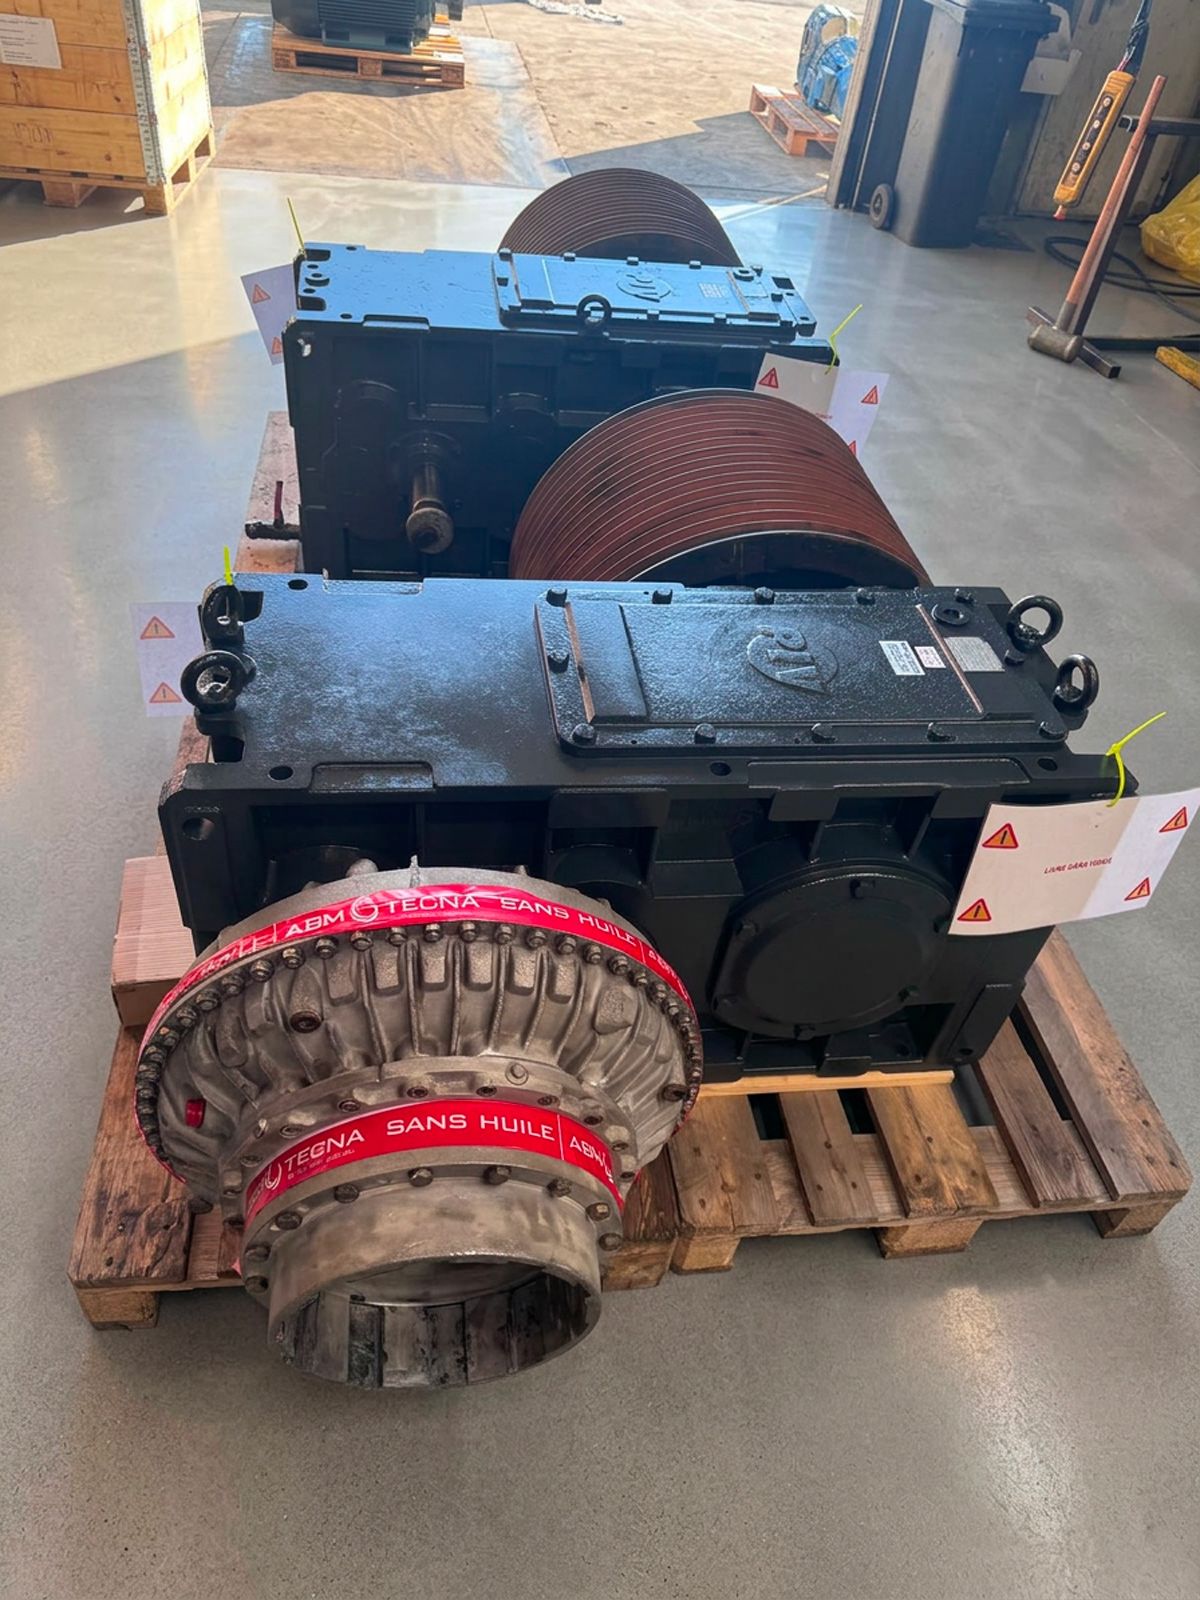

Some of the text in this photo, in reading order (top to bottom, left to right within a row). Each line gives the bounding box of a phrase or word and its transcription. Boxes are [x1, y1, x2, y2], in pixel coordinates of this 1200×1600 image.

[285, 910, 345, 938] ABM
[386, 895, 480, 914] TECNA
[500, 898, 570, 919] SANS
[386, 1114, 468, 1136] SANS
[480, 1114, 555, 1141] HUILE
